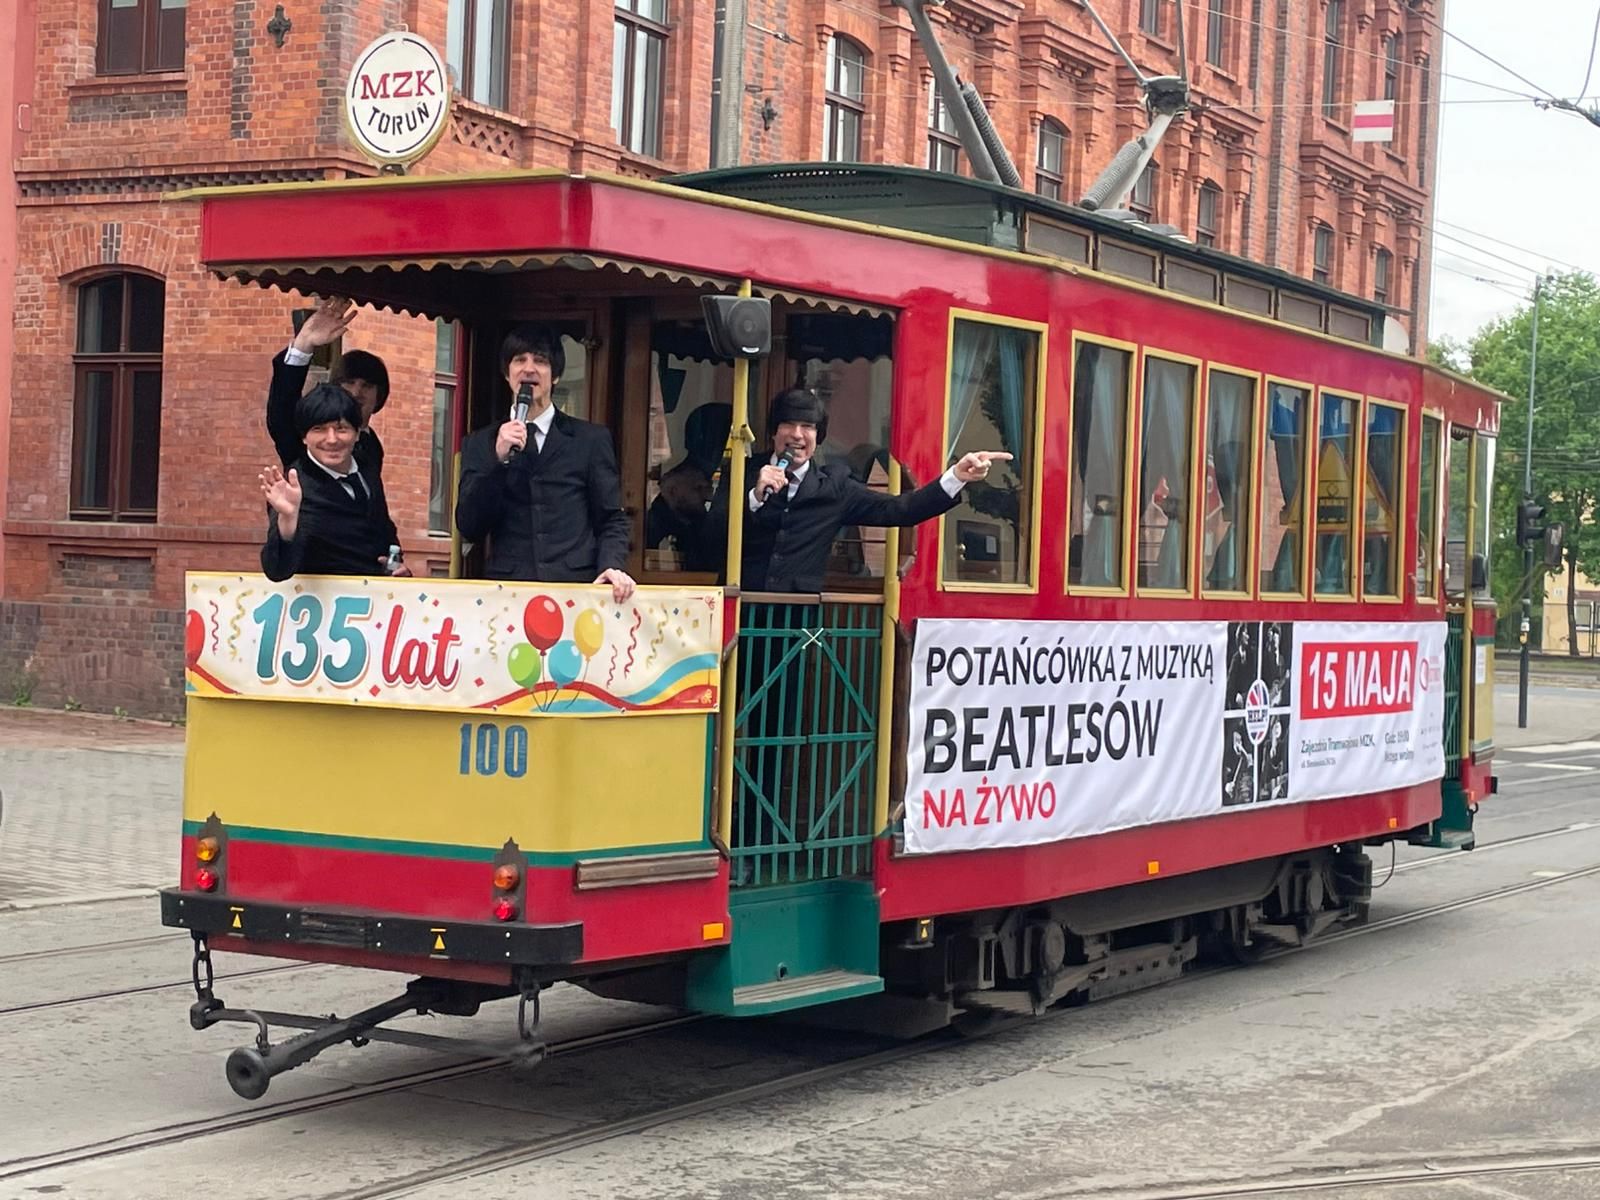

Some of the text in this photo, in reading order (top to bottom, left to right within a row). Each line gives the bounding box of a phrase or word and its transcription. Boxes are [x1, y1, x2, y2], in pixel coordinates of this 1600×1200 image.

[361, 70, 435, 99] MZK
[368, 101, 429, 135] TORUŃ
[253, 593, 462, 691] 135 lat
[926, 636, 1214, 686] POTAŃCÓWKA Z MUZYKĄ
[1309, 651, 1338, 709] 15
[1344, 650, 1411, 707] MAJA
[459, 723, 529, 778] 100
[923, 684, 1163, 774] BEATLESÓW
[923, 776, 1057, 829] NA ŻYWO
